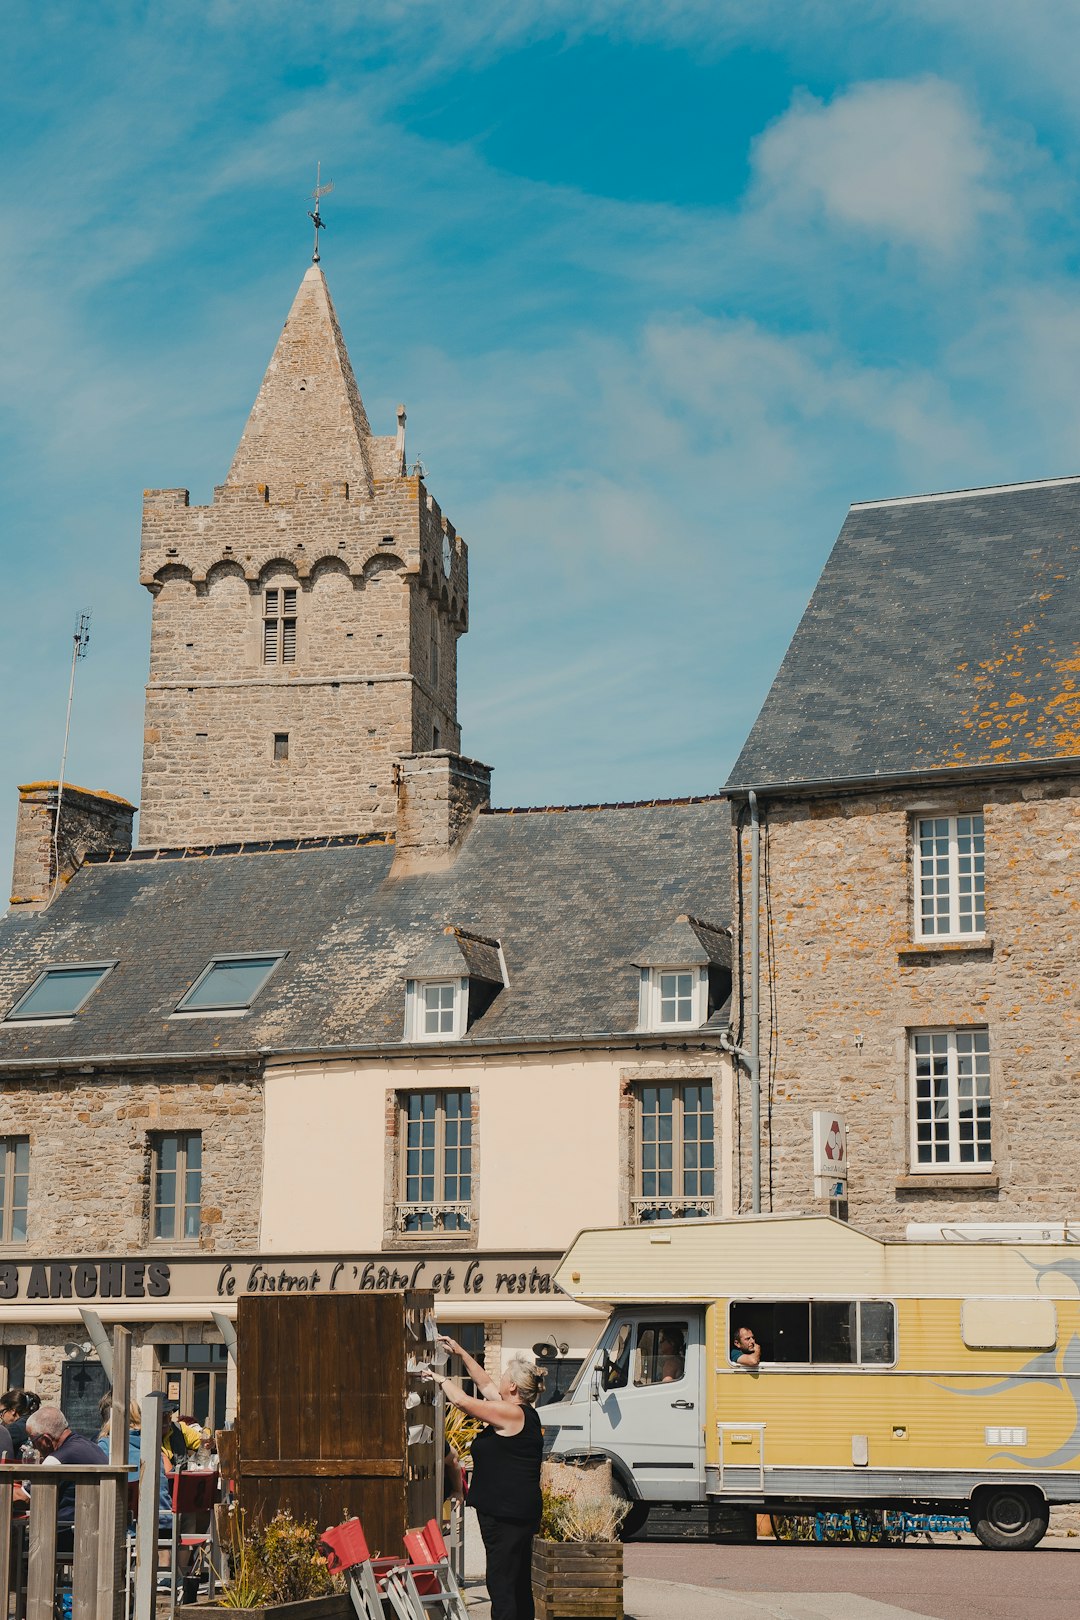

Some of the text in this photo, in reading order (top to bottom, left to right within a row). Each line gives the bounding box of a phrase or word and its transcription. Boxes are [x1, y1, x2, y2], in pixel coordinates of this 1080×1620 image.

[0, 1262, 171, 1299] 3 ARCHES
[217, 1263, 236, 1296] le
[246, 1263, 321, 1292] bistrot
[431, 1266, 455, 1294] et
[463, 1261, 484, 1294] le
